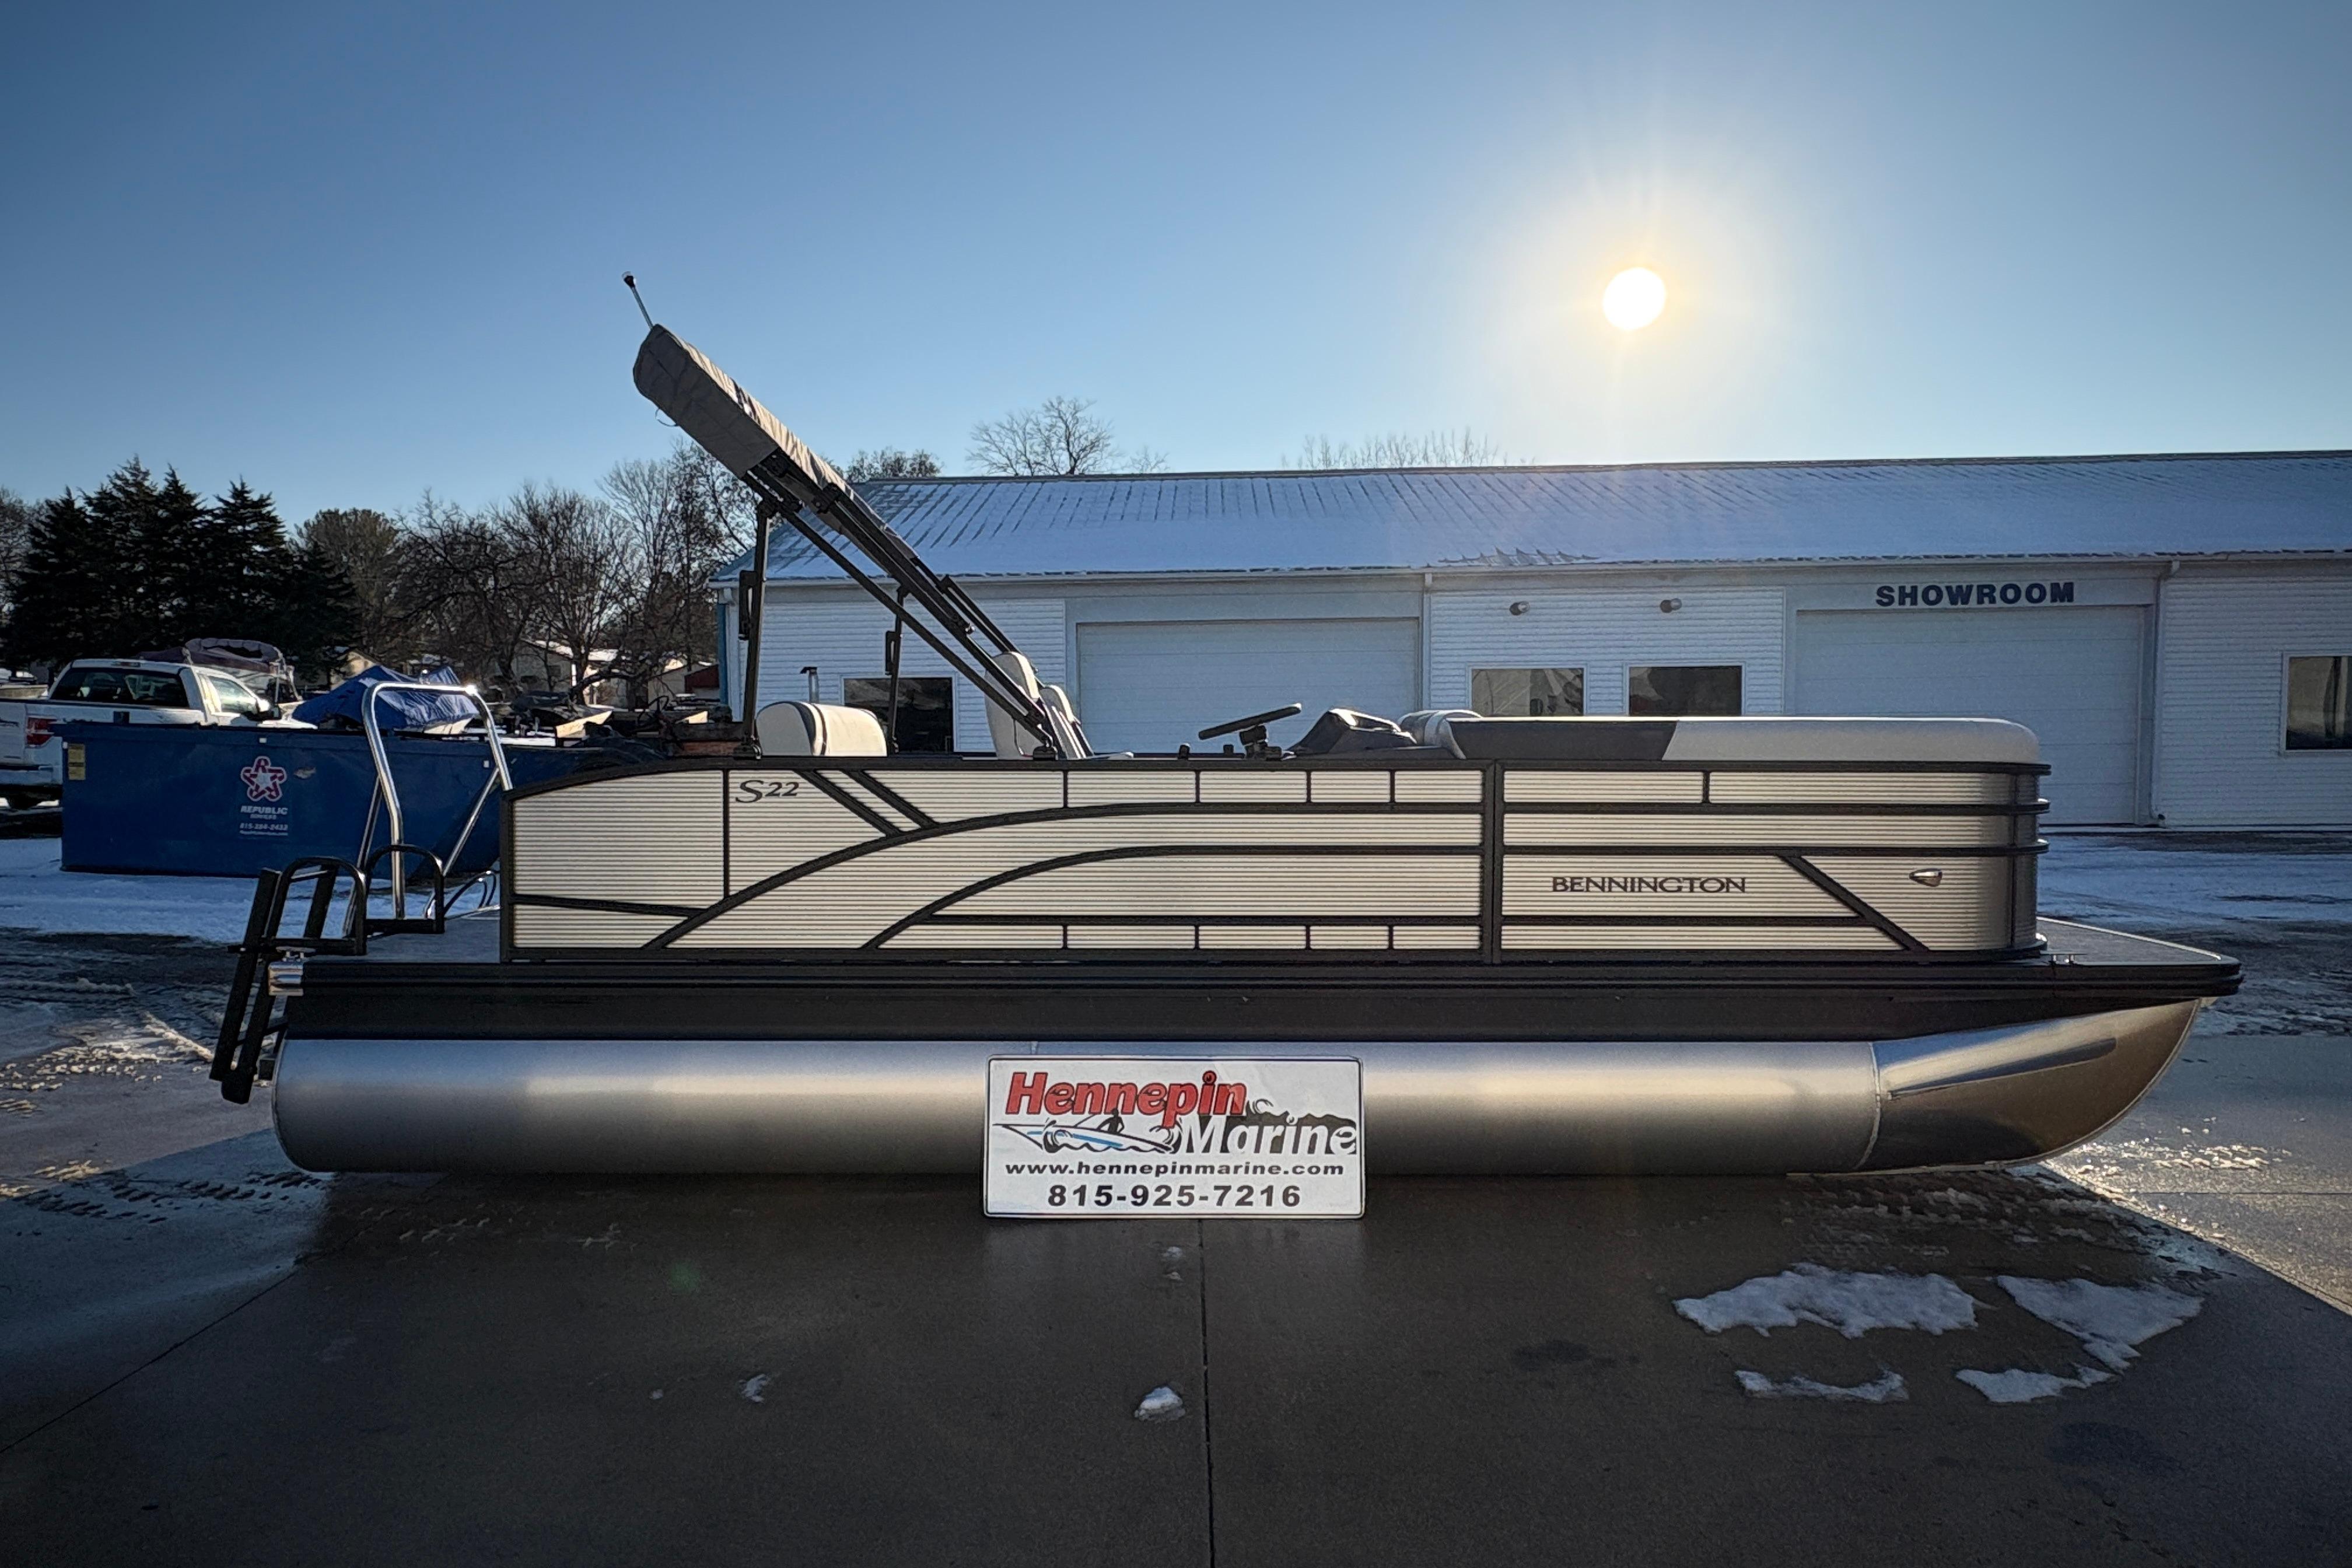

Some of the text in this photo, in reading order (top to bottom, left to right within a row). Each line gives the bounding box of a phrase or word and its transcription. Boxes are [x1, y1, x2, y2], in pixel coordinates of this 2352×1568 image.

[1875, 582, 2074, 607] SHOWROOM
[735, 779, 799, 803] S22
[240, 805, 288, 815] REPUBLIC
[1552, 876, 1746, 893] BENNINGTON
[1005, 1070, 1247, 1129] Hennepin
[1178, 1114, 1357, 1155] Marine
[1005, 1161, 1344, 1177] www.hennepinmarine.com
[1048, 1184, 1301, 1206] 815-925-7216
